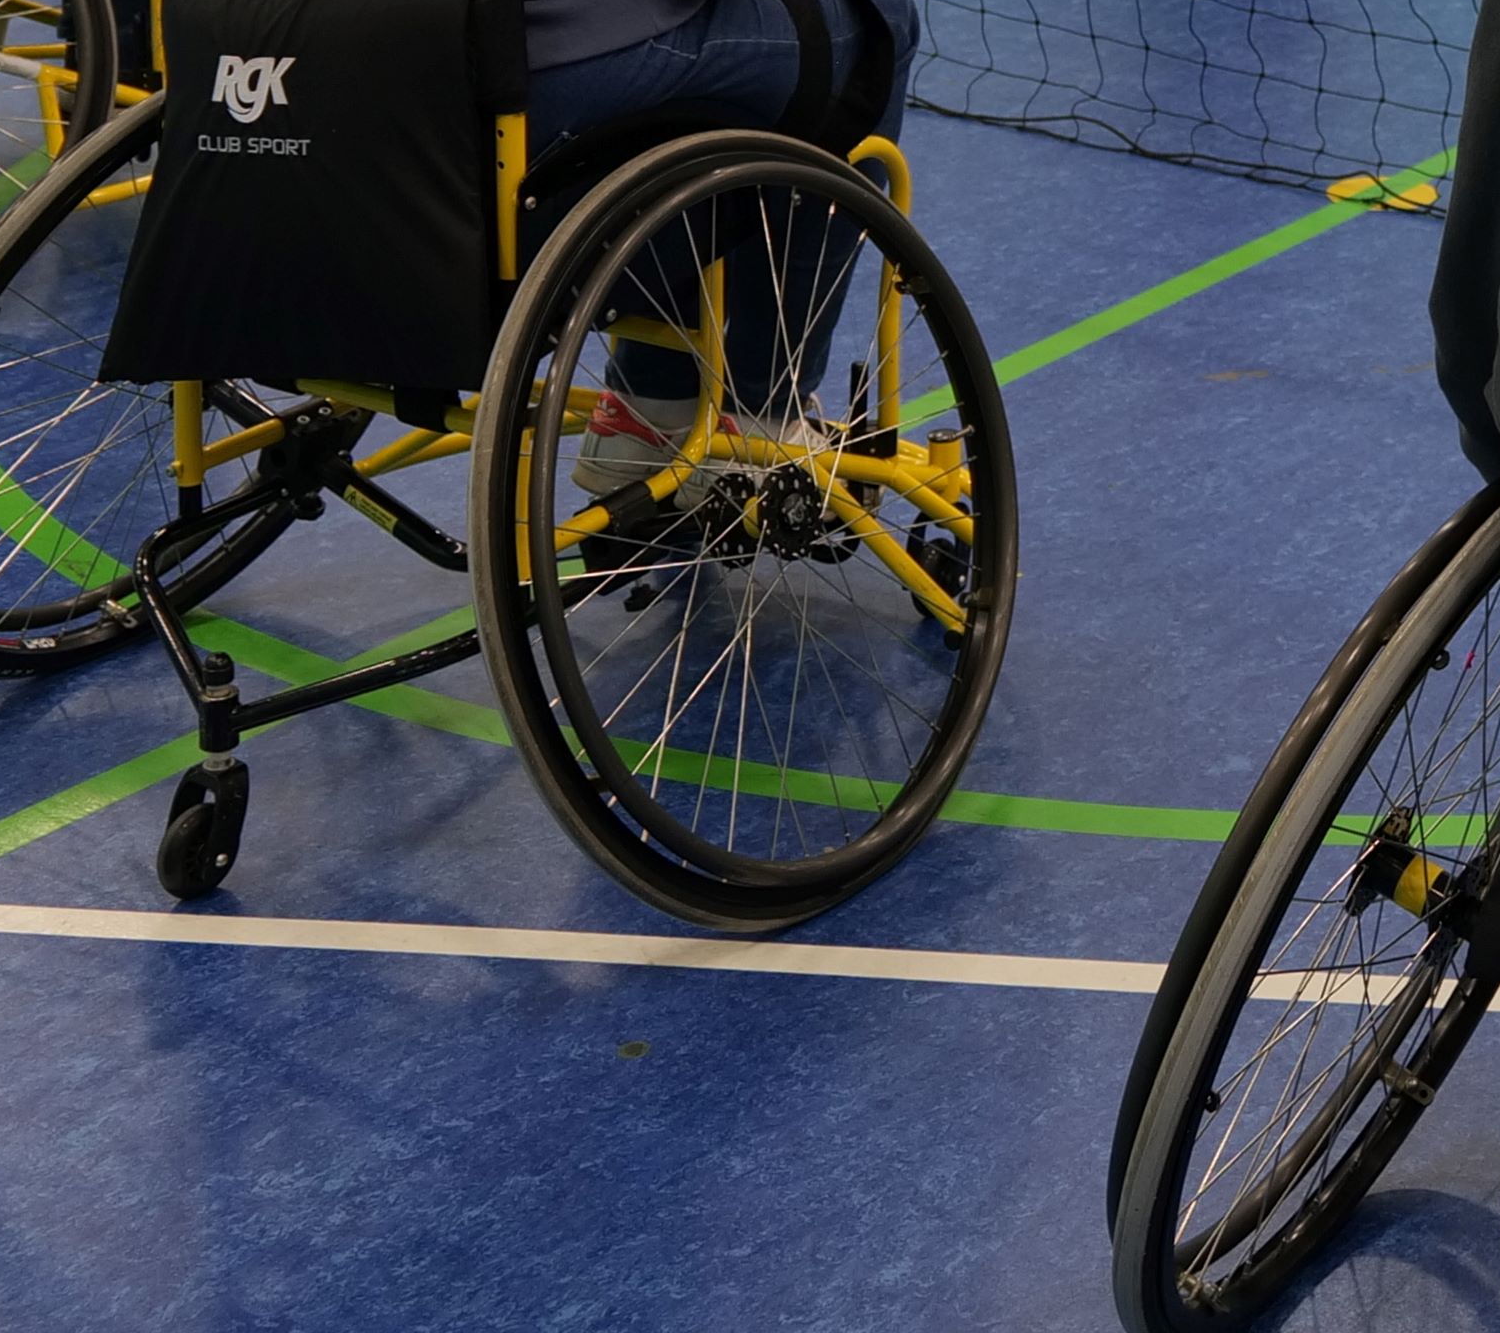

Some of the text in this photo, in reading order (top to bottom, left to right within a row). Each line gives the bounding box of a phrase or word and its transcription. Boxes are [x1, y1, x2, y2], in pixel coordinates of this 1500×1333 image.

[212, 55, 296, 123] RGK
[198, 134, 310, 156] CLUB SPORT
